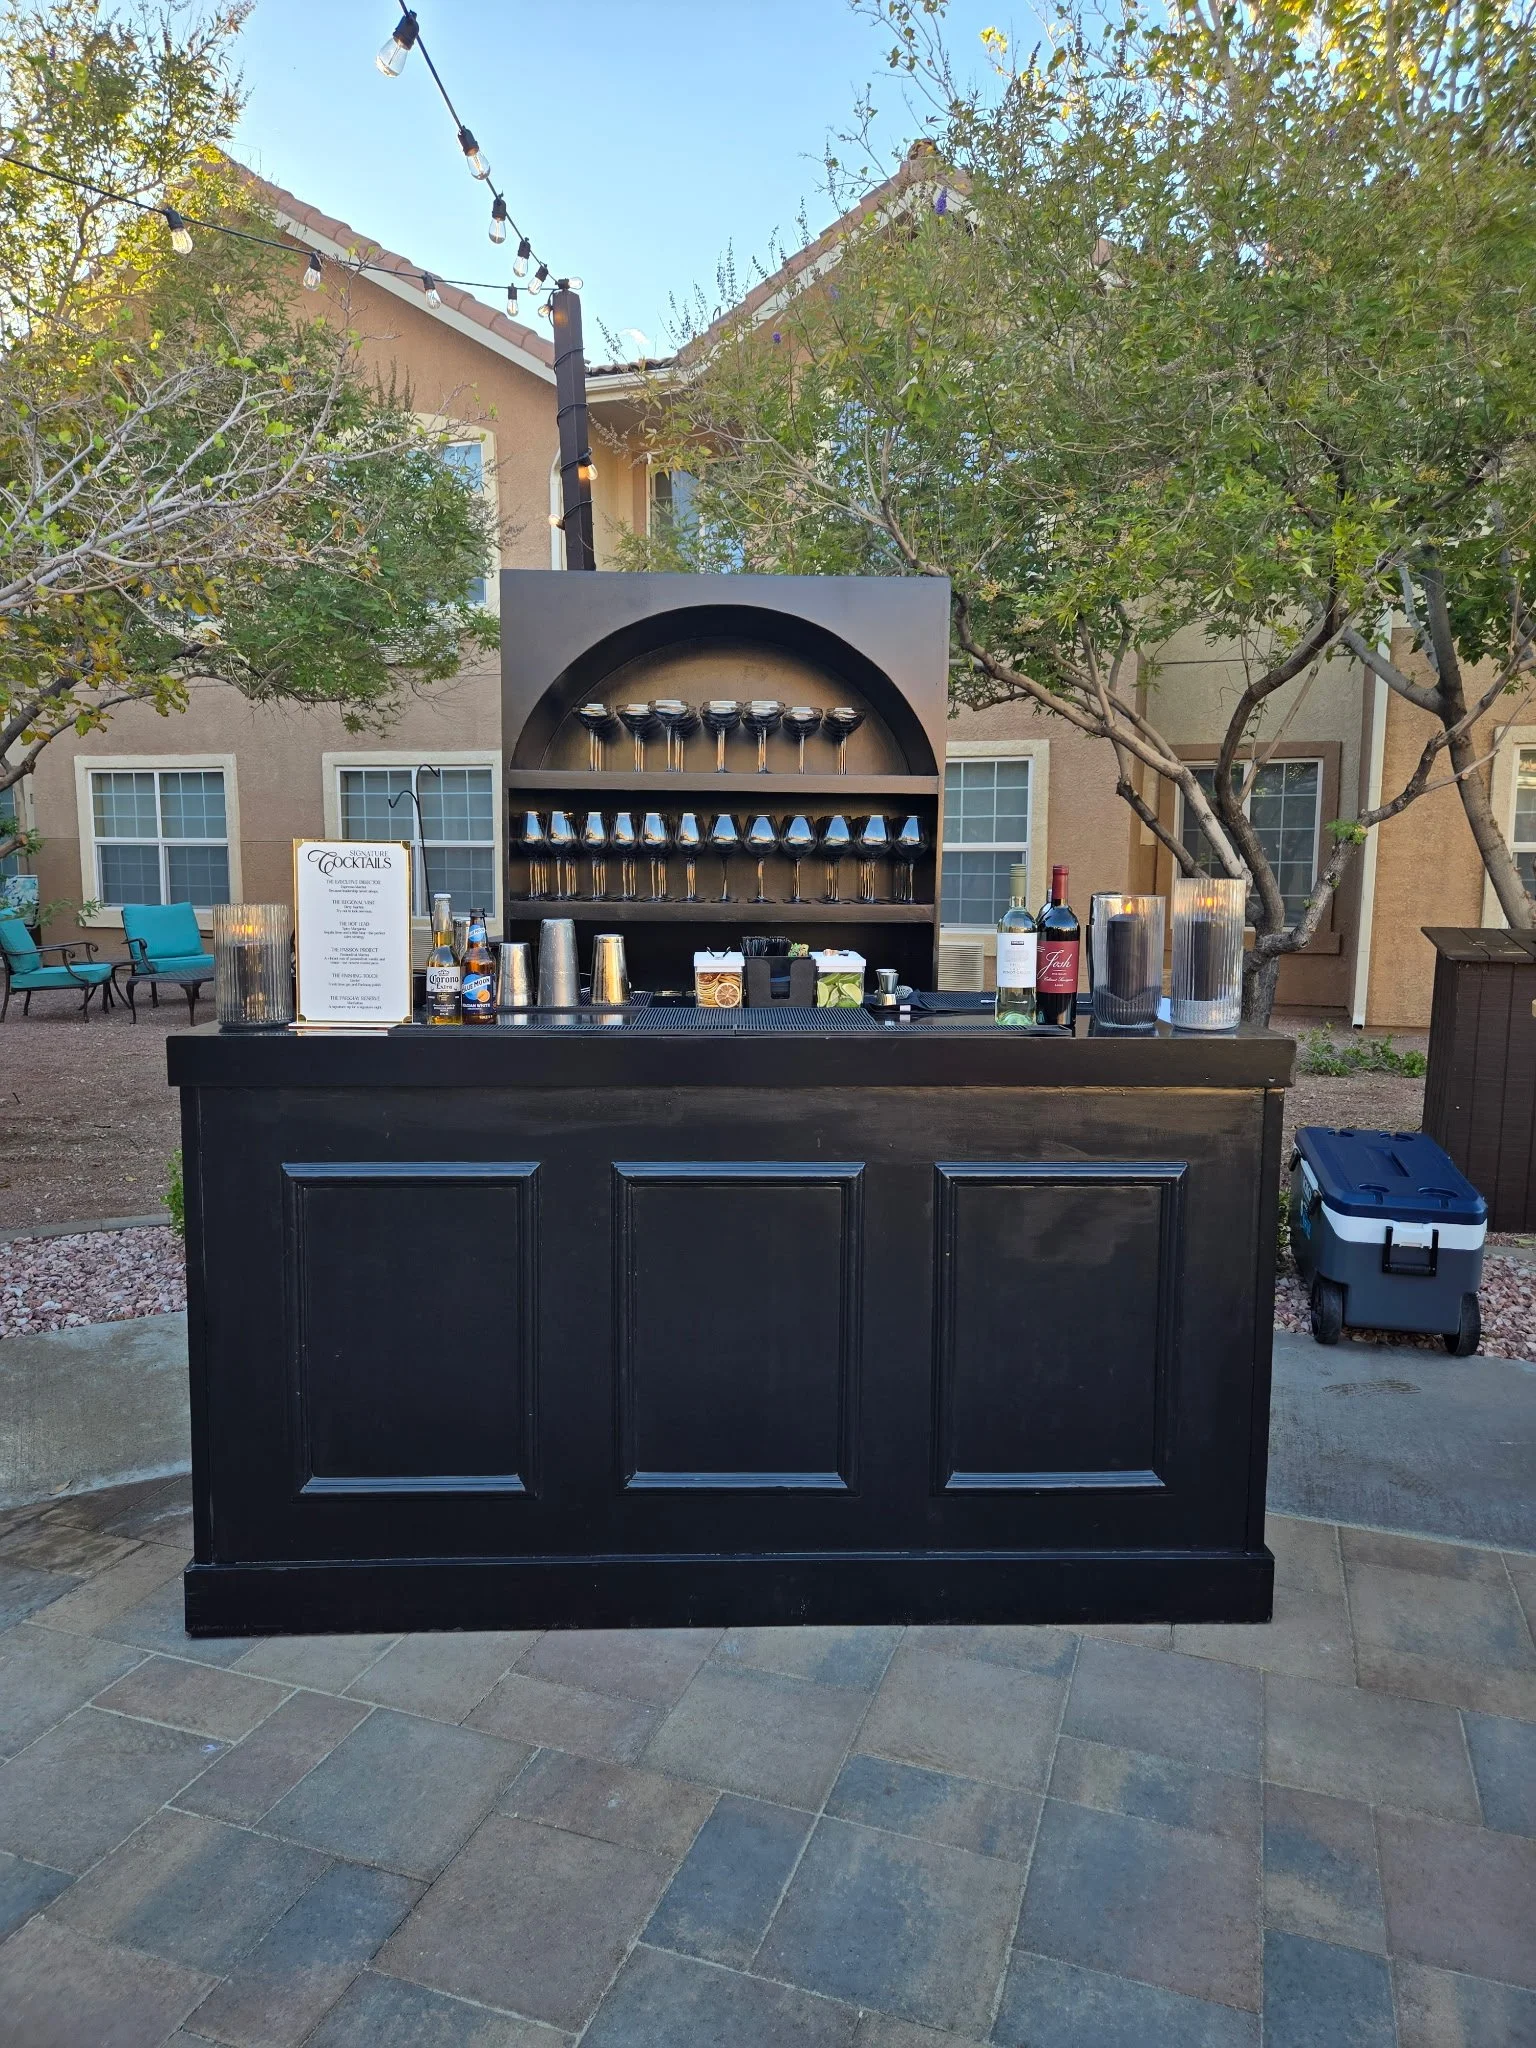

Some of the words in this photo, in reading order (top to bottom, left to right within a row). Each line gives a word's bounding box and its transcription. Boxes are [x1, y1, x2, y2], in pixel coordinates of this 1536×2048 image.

[307, 849, 392, 878] COCKTAILS
[1037, 949, 1072, 979] Josh
[429, 974, 459, 985] Corona
[462, 984, 473, 994] BLUE
[474, 978, 490, 988] MOON
